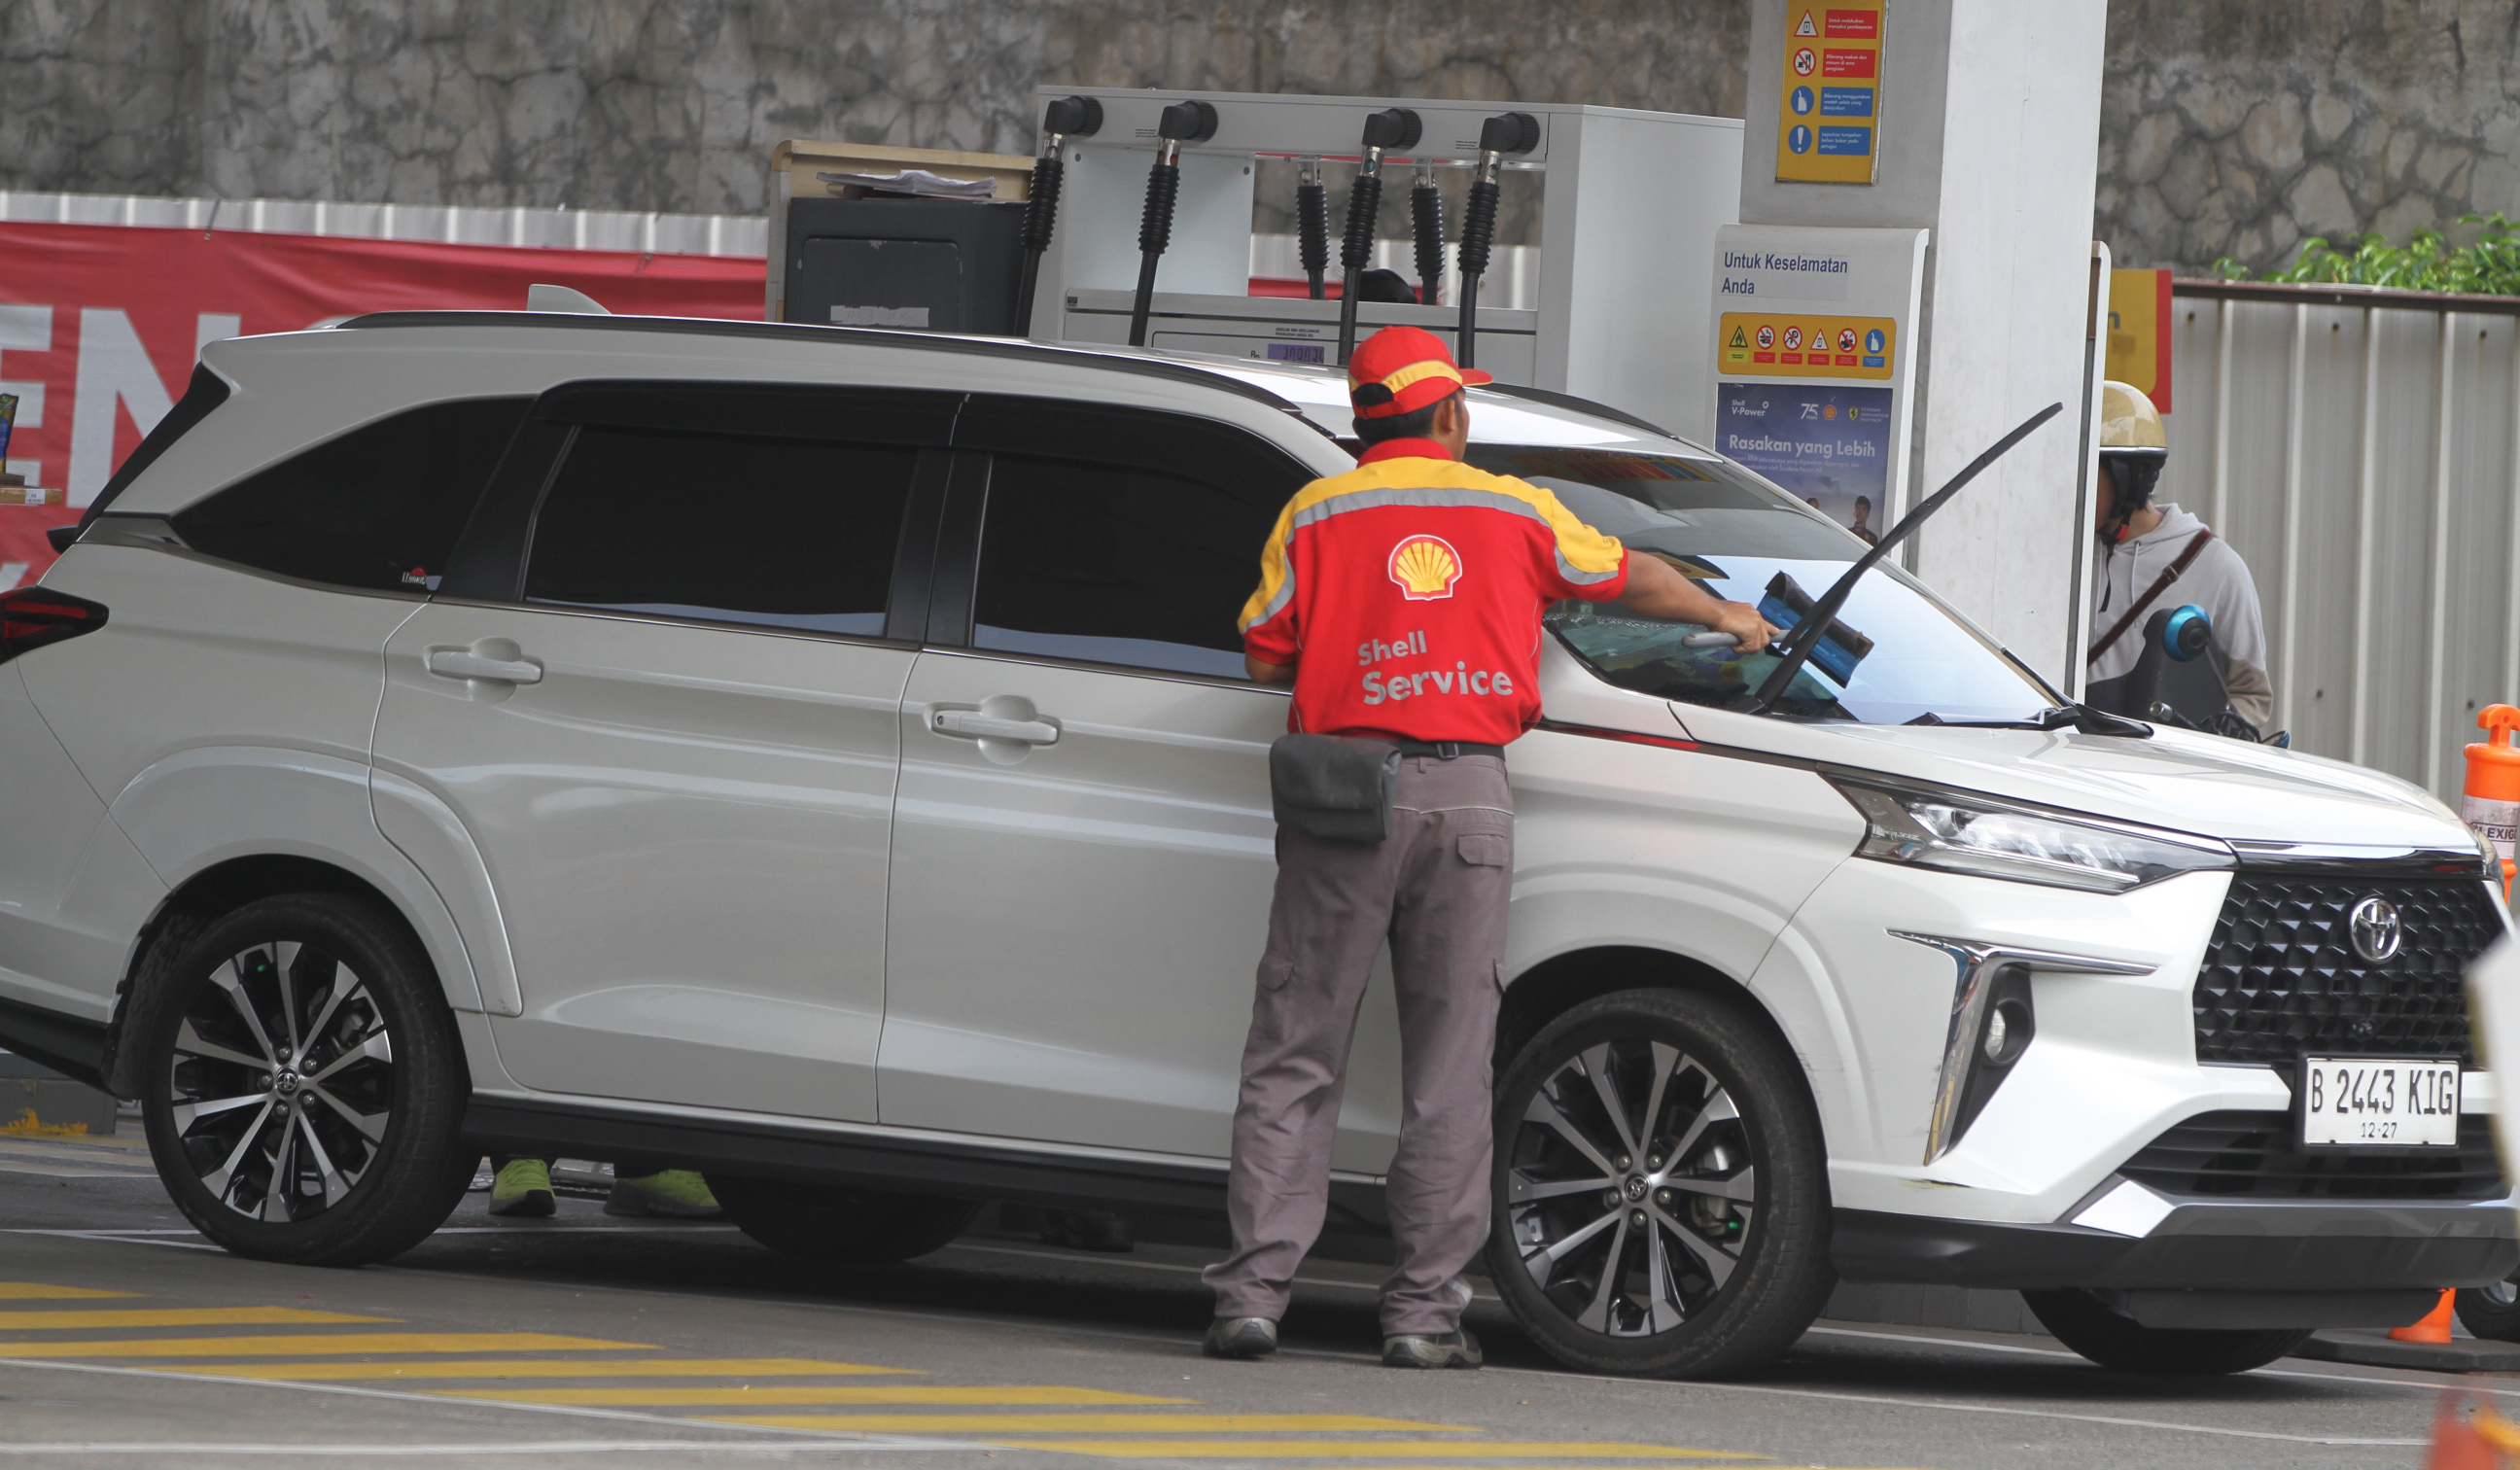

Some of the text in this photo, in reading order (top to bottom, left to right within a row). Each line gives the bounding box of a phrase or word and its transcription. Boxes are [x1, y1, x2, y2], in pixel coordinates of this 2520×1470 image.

[1724, 251, 1848, 273] Untuk Keselamatan
[1721, 277, 1755, 295] Anda
[1732, 406, 1766, 416] V-Power
[1801, 403, 1819, 420] 75
[1729, 434, 1875, 459] Rasakan yang Lebih
[1357, 630, 1427, 666] Shell
[1362, 661, 1513, 706] Service
[2311, 1068, 2453, 1115] B 2443 KIG
